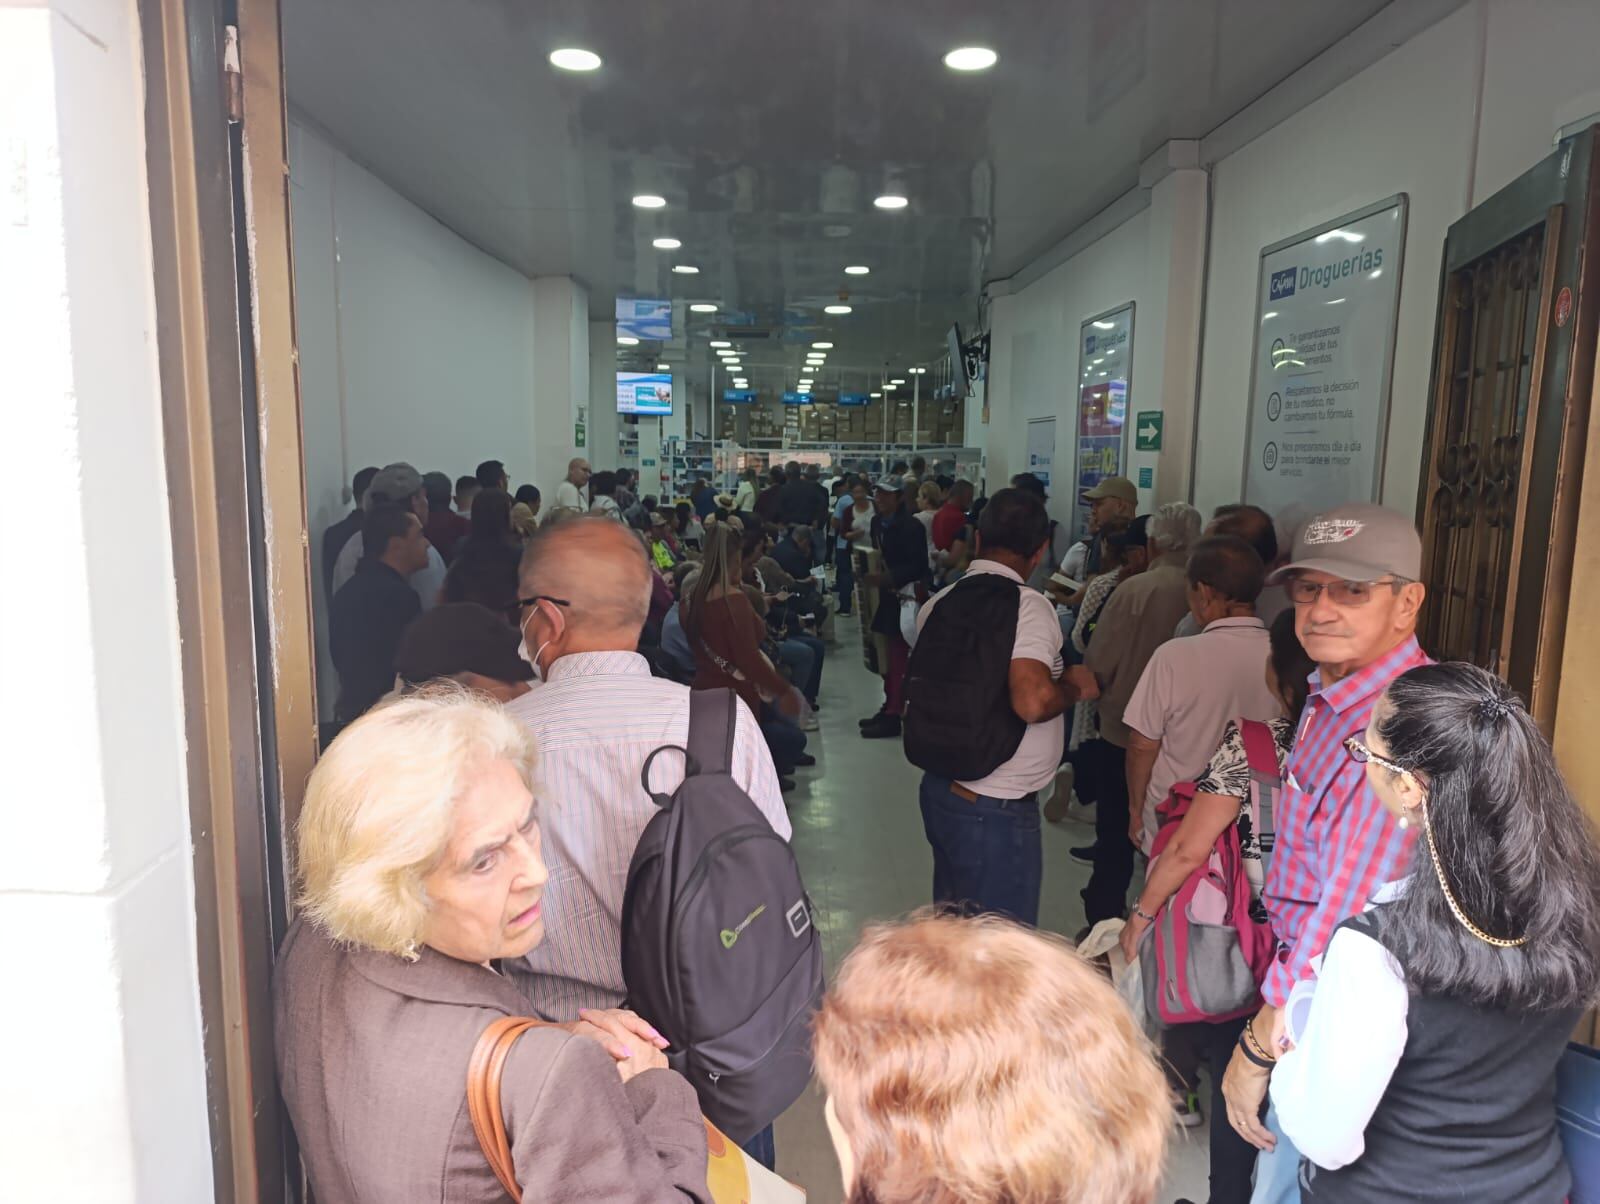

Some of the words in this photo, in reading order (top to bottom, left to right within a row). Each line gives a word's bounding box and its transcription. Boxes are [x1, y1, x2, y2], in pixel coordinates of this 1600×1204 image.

[1299, 246, 1383, 290] Droguerías
[1323, 383, 1330, 393] la
[1330, 379, 1359, 392] decisión
[1285, 401, 1293, 409] de
[1326, 398, 1335, 406] no
[1319, 411, 1326, 420] tu
[1327, 407, 1354, 419] fórmula.
